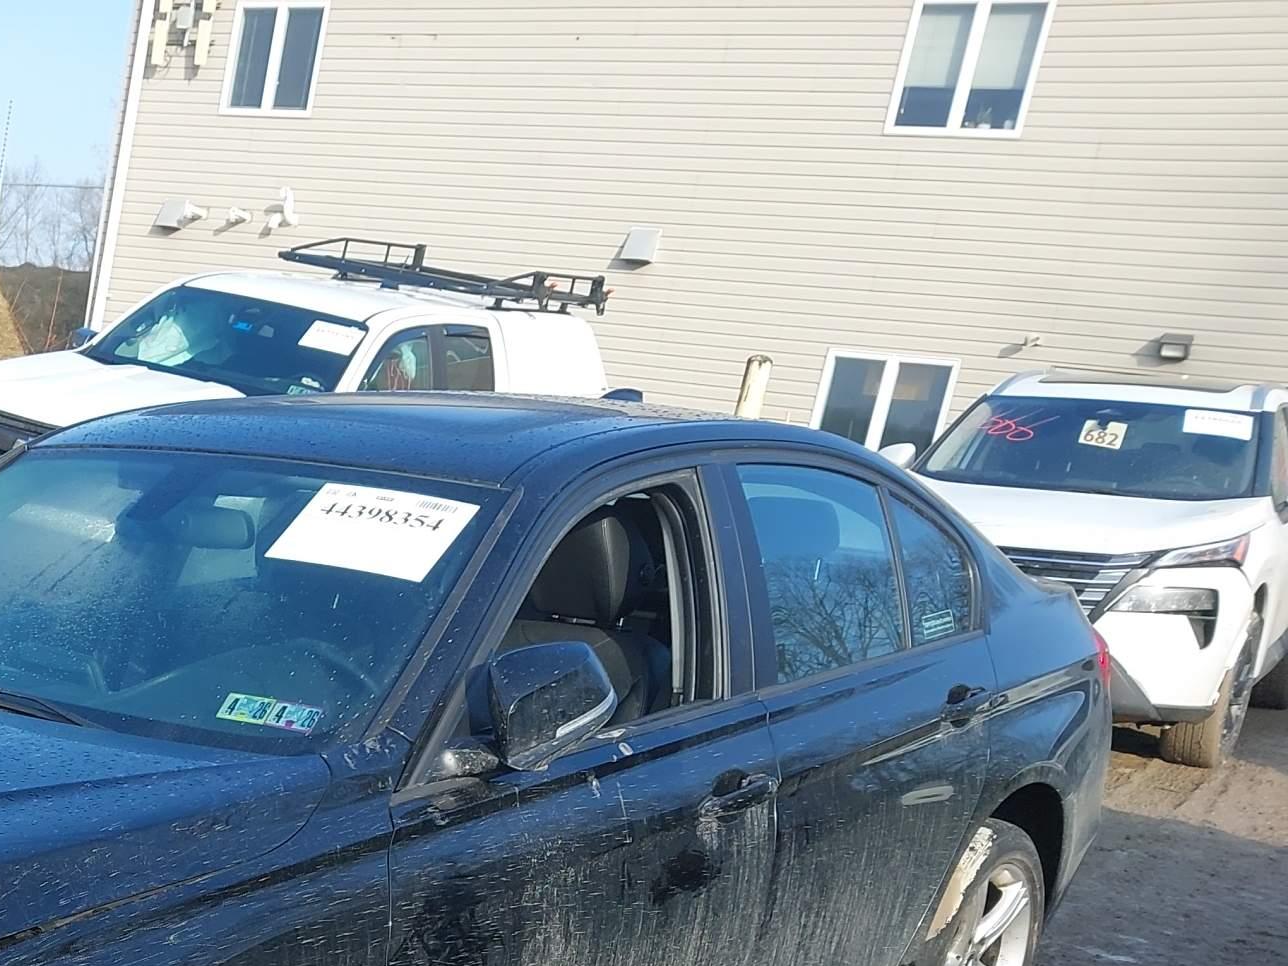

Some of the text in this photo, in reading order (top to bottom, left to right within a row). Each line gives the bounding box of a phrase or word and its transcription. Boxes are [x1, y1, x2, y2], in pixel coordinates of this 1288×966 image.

[1084, 430, 1119, 447] 682
[320, 502, 445, 531] 44398354
[226, 698, 271, 720] 4 26
[275, 705, 319, 728] 4 26
